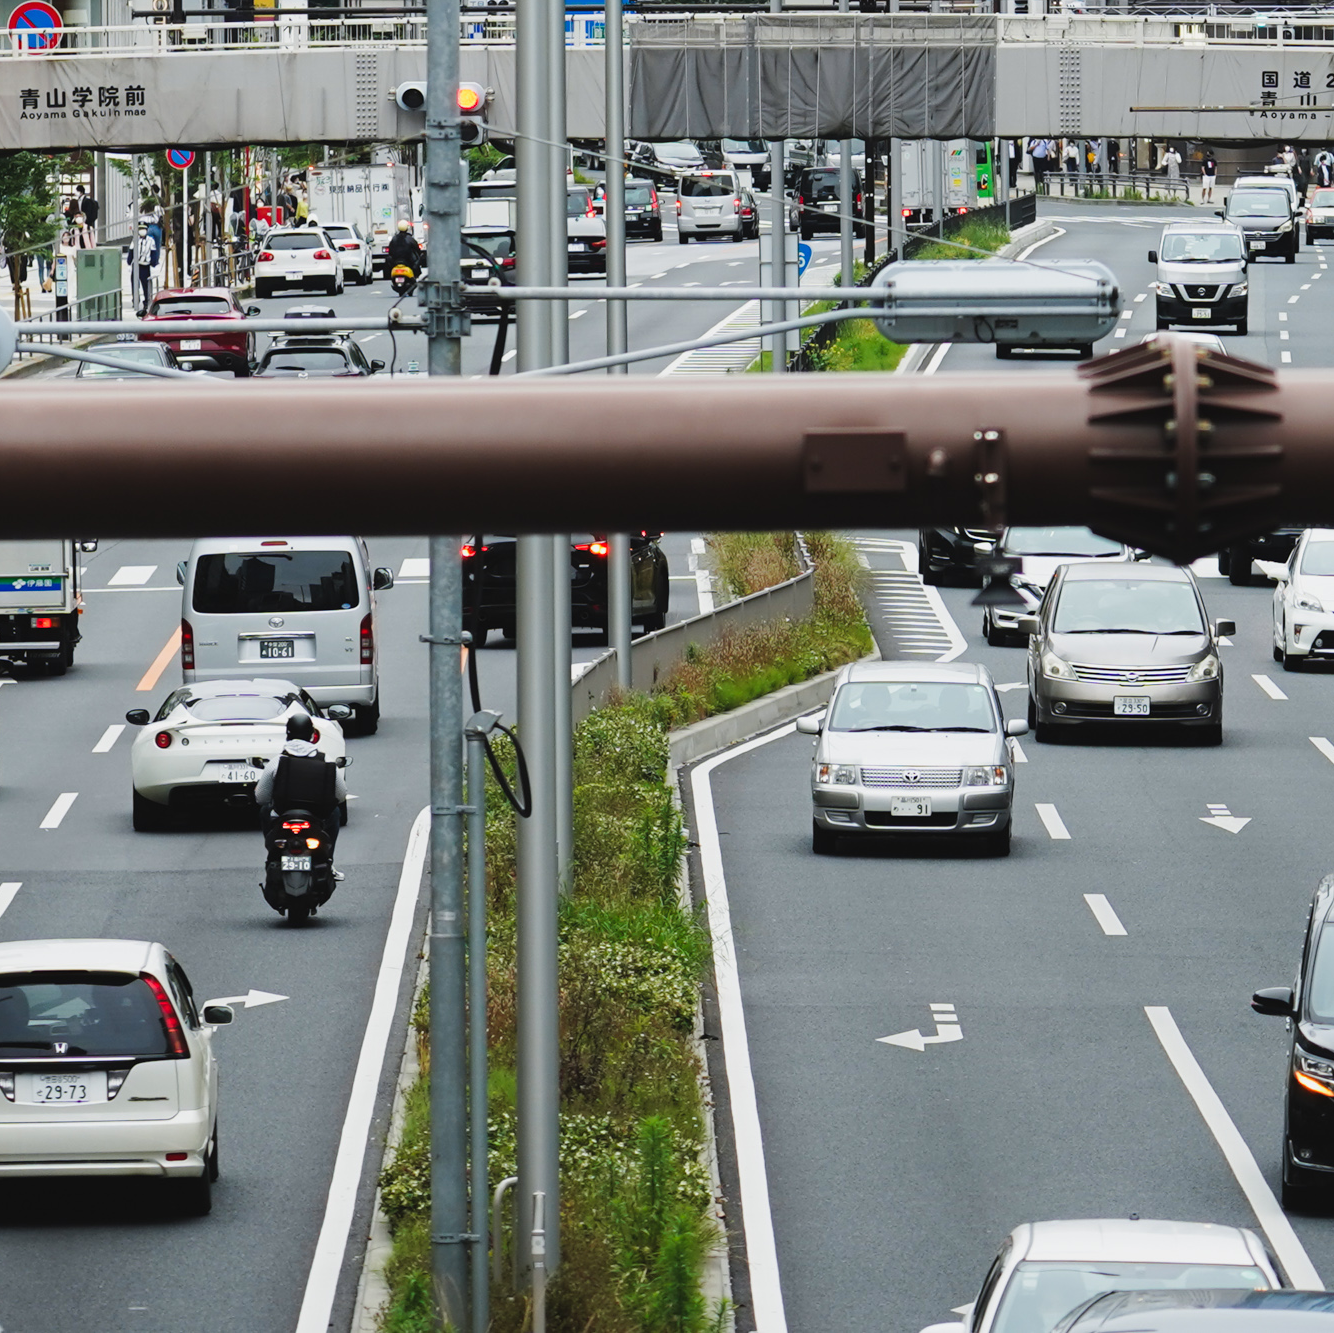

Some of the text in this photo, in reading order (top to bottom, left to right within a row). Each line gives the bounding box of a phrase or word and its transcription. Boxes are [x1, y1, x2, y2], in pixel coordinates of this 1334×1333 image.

[19, 85, 146, 110] 青山学院前
[20, 108, 147, 121] Aoyama Gakuin mae
[268, 647, 293, 657] 10-61
[1122, 703, 1148, 713] 29-50
[227, 769, 256, 780] 41-60
[282, 861, 311, 869] 29-10
[45, 1084, 88, 1099] 29-73
